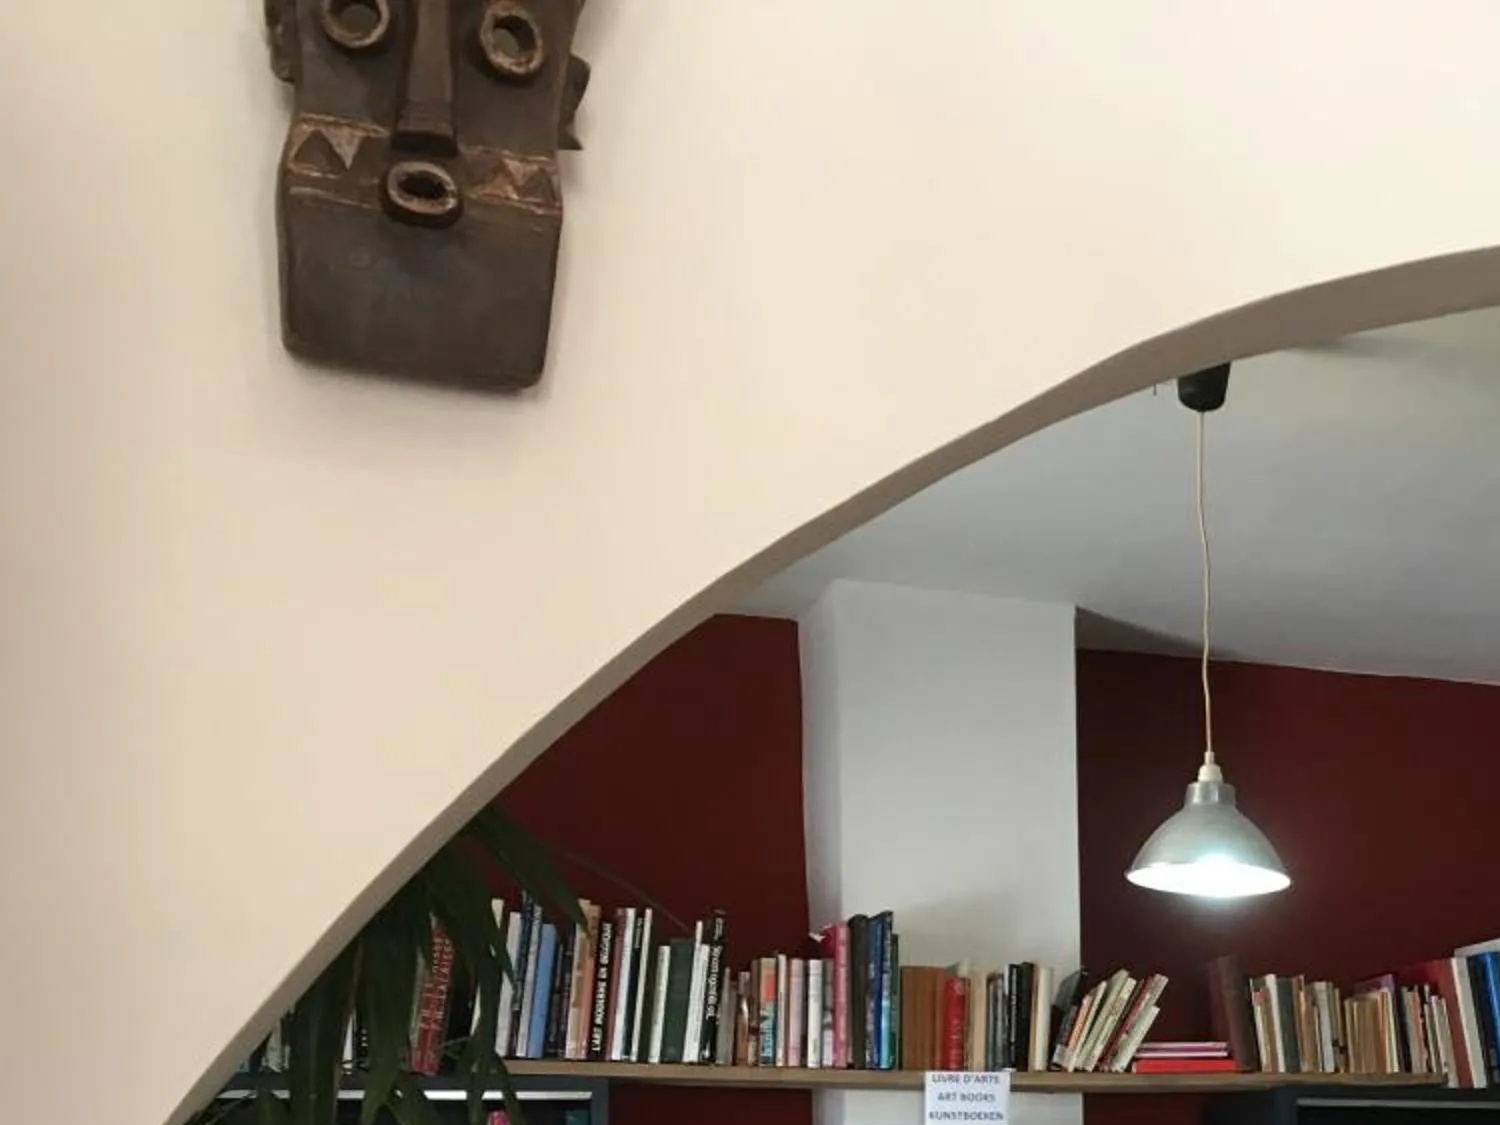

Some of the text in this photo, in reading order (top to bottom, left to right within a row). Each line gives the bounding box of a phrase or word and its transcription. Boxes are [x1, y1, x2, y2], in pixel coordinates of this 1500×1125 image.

[937, 1092, 996, 1103] ART BOOKS
[928, 1111, 1004, 1121] KUNSTBOEKEN
